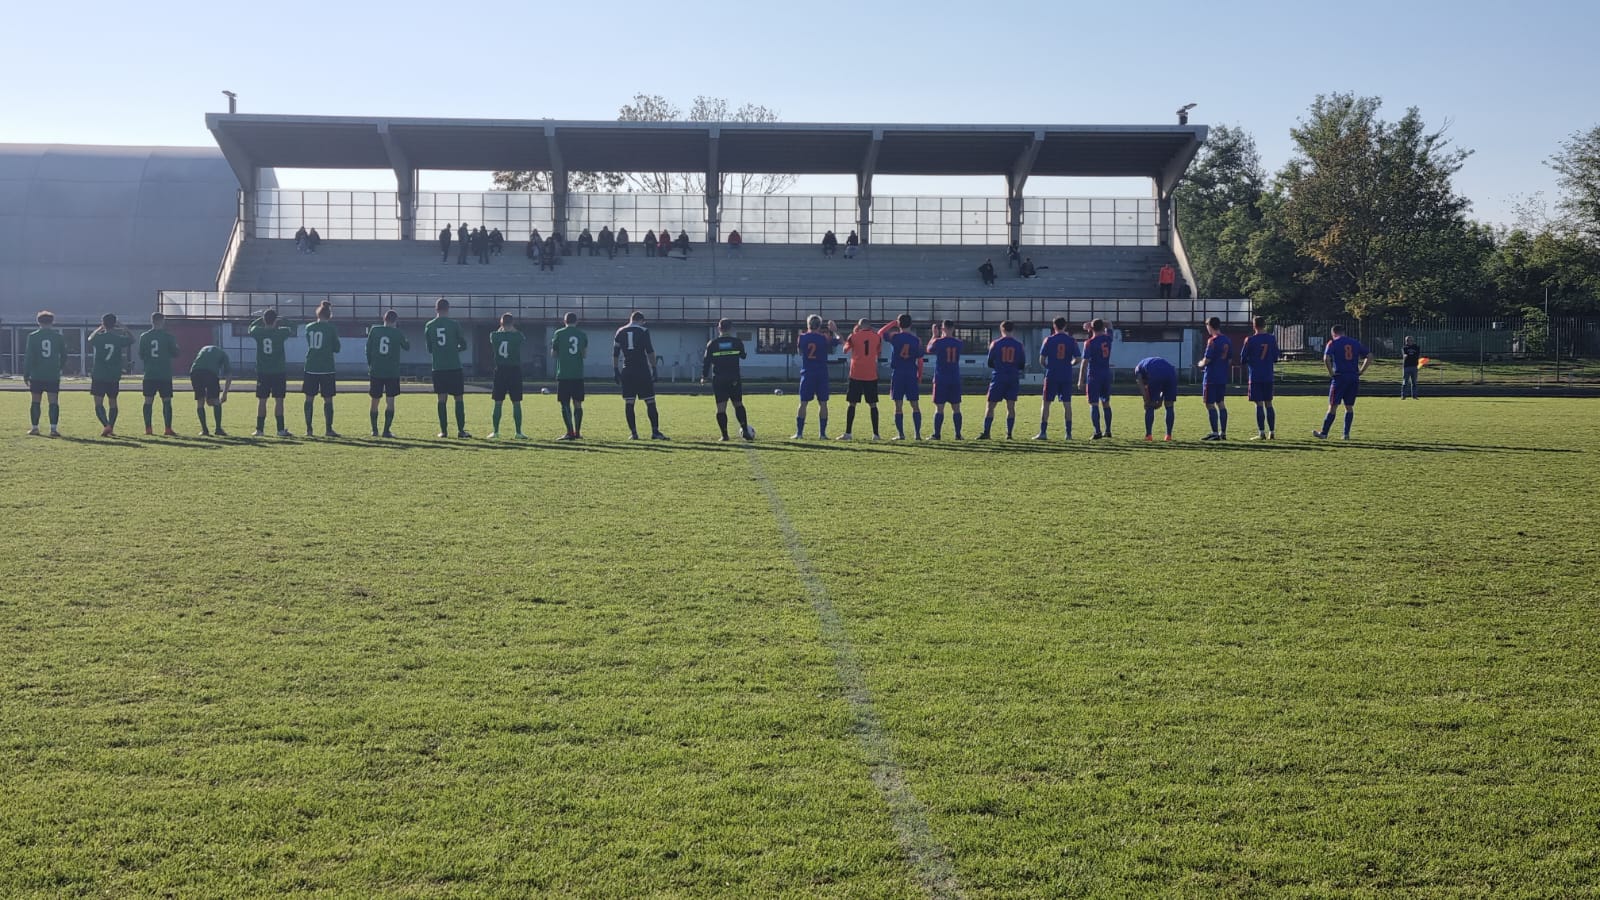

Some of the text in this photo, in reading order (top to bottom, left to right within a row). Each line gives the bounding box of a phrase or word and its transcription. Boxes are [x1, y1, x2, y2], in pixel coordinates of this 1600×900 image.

[308, 332, 323, 348] 10
[380, 336, 389, 354] 6
[436, 328, 446, 346] 5
[569, 336, 578, 354] 3
[627, 332, 634, 349] 1
[42, 340, 51, 358] 9
[104, 344, 114, 360] 7
[150, 340, 158, 358] 2
[263, 338, 272, 354] 8
[498, 342, 508, 358] 4
[808, 343, 816, 358] 2
[864, 340, 869, 356] 1
[900, 344, 910, 358] 4
[1260, 344, 1268, 360] 7
[1344, 345, 1352, 360] 8
[946, 348, 956, 362] 11
[1002, 348, 1014, 362] 10
